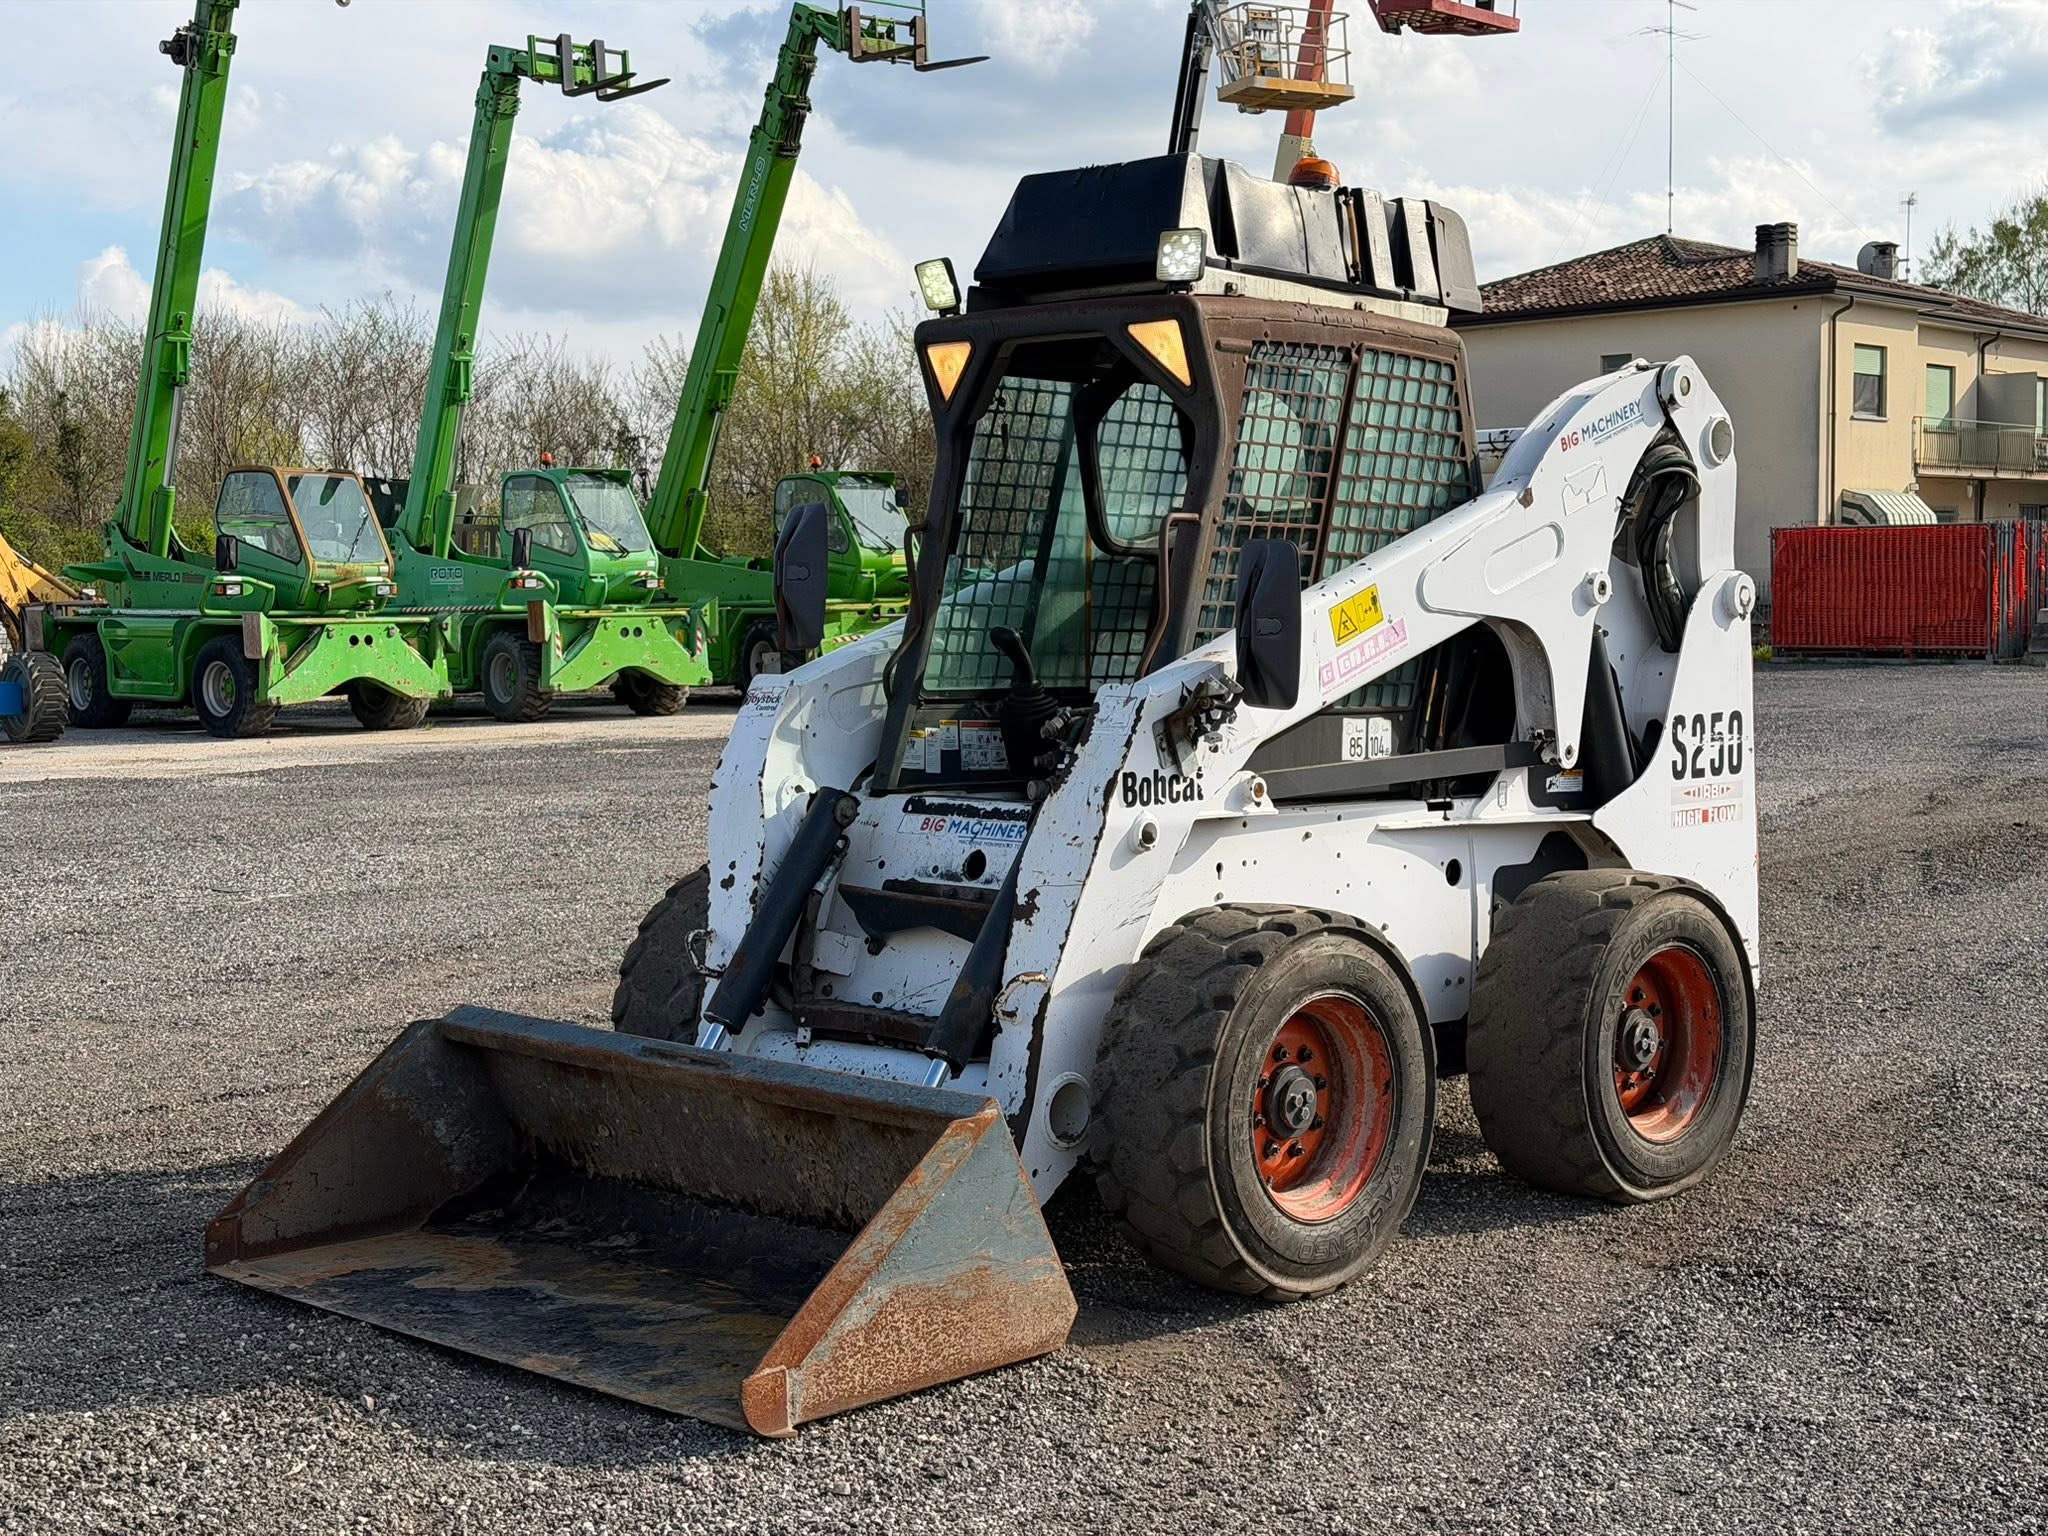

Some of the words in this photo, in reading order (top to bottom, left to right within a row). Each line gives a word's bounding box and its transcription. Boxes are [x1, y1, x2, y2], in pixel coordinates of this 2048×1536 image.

[739, 156, 766, 232] MERLO
[1560, 432, 1580, 453] BIG
[1581, 398, 1641, 442] MACHINERY
[152, 571, 180, 583] MERLO
[430, 567, 463, 579] ROTO
[1349, 736, 1364, 758] 85
[1370, 736, 1384, 757] 104
[1671, 709, 1743, 781] S250
[1121, 766, 1205, 808] Bobcat
[919, 816, 947, 832] BIG
[947, 819, 1027, 839] MACHINER
